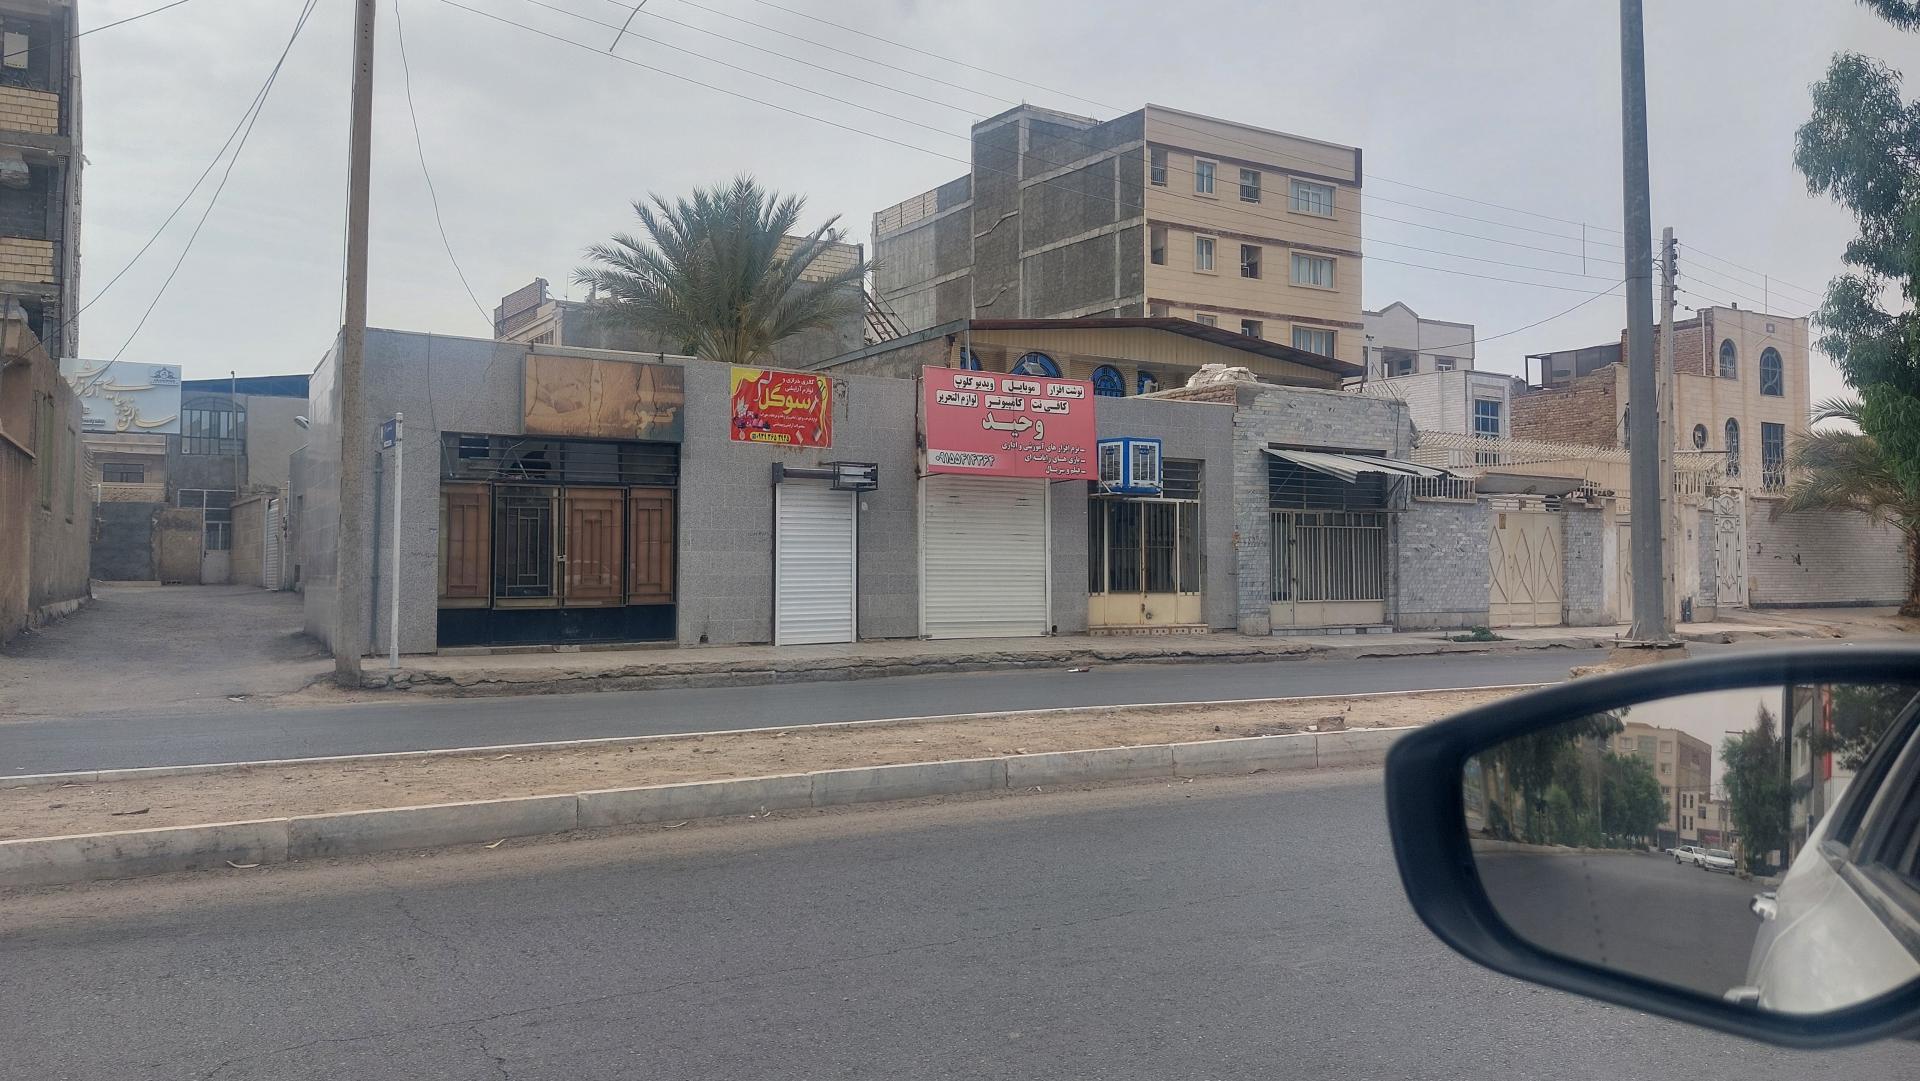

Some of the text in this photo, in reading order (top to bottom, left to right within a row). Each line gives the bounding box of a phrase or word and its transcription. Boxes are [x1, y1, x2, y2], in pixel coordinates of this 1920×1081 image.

[1008, 381, 1036, 393] موبایل
[1050, 385, 1083, 397] نوشت افزار
[759, 383, 812, 415] سوگل
[938, 392, 977, 406] لوازم التحریر
[987, 396, 1022, 409] کامپیوتر
[1032, 398, 1067, 412] کافی نت
[981, 410, 1045, 440] وحید
[1001, 441, 1018, 450] اداری
[1023, 442, 1044, 452] آموزشی
[1045, 443, 1057, 452] های
[1052, 455, 1067, 464] های
[1068, 456, 1081, 465] بازی
[1046, 465, 1065, 475] سریال
[1070, 466, 1081, 474] فیلم
